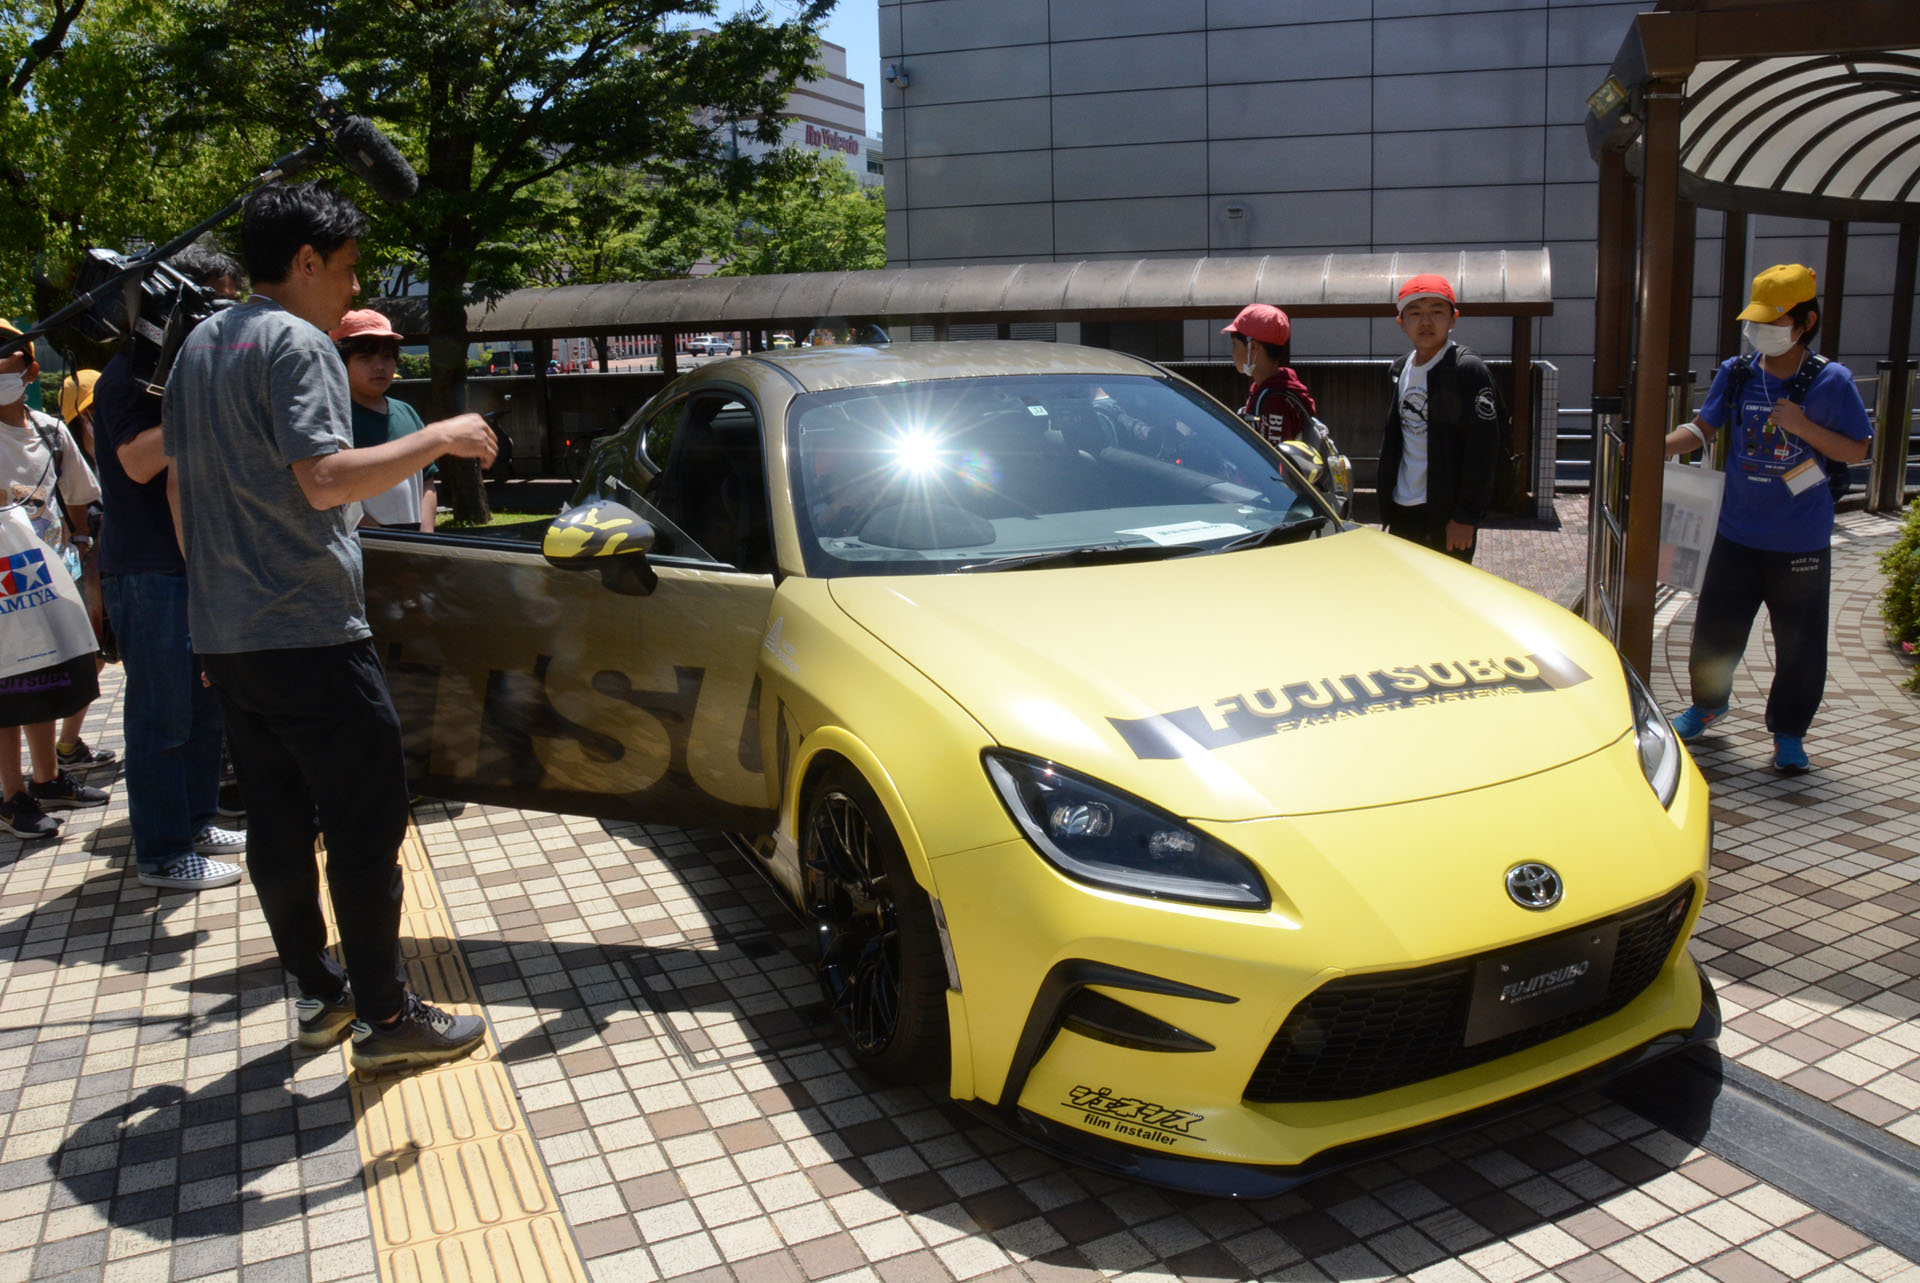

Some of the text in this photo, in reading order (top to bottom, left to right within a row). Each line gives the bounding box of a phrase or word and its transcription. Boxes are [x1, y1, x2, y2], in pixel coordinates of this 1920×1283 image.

[821, 128, 859, 155] Yokado
[1200, 655, 1541, 731] FUJITSUBO
[1273, 684, 1524, 733] EXHAUST SYSTEMS
[1500, 960, 1589, 1001] FUJITSUBO
[1083, 1113, 1178, 1147] film installer
